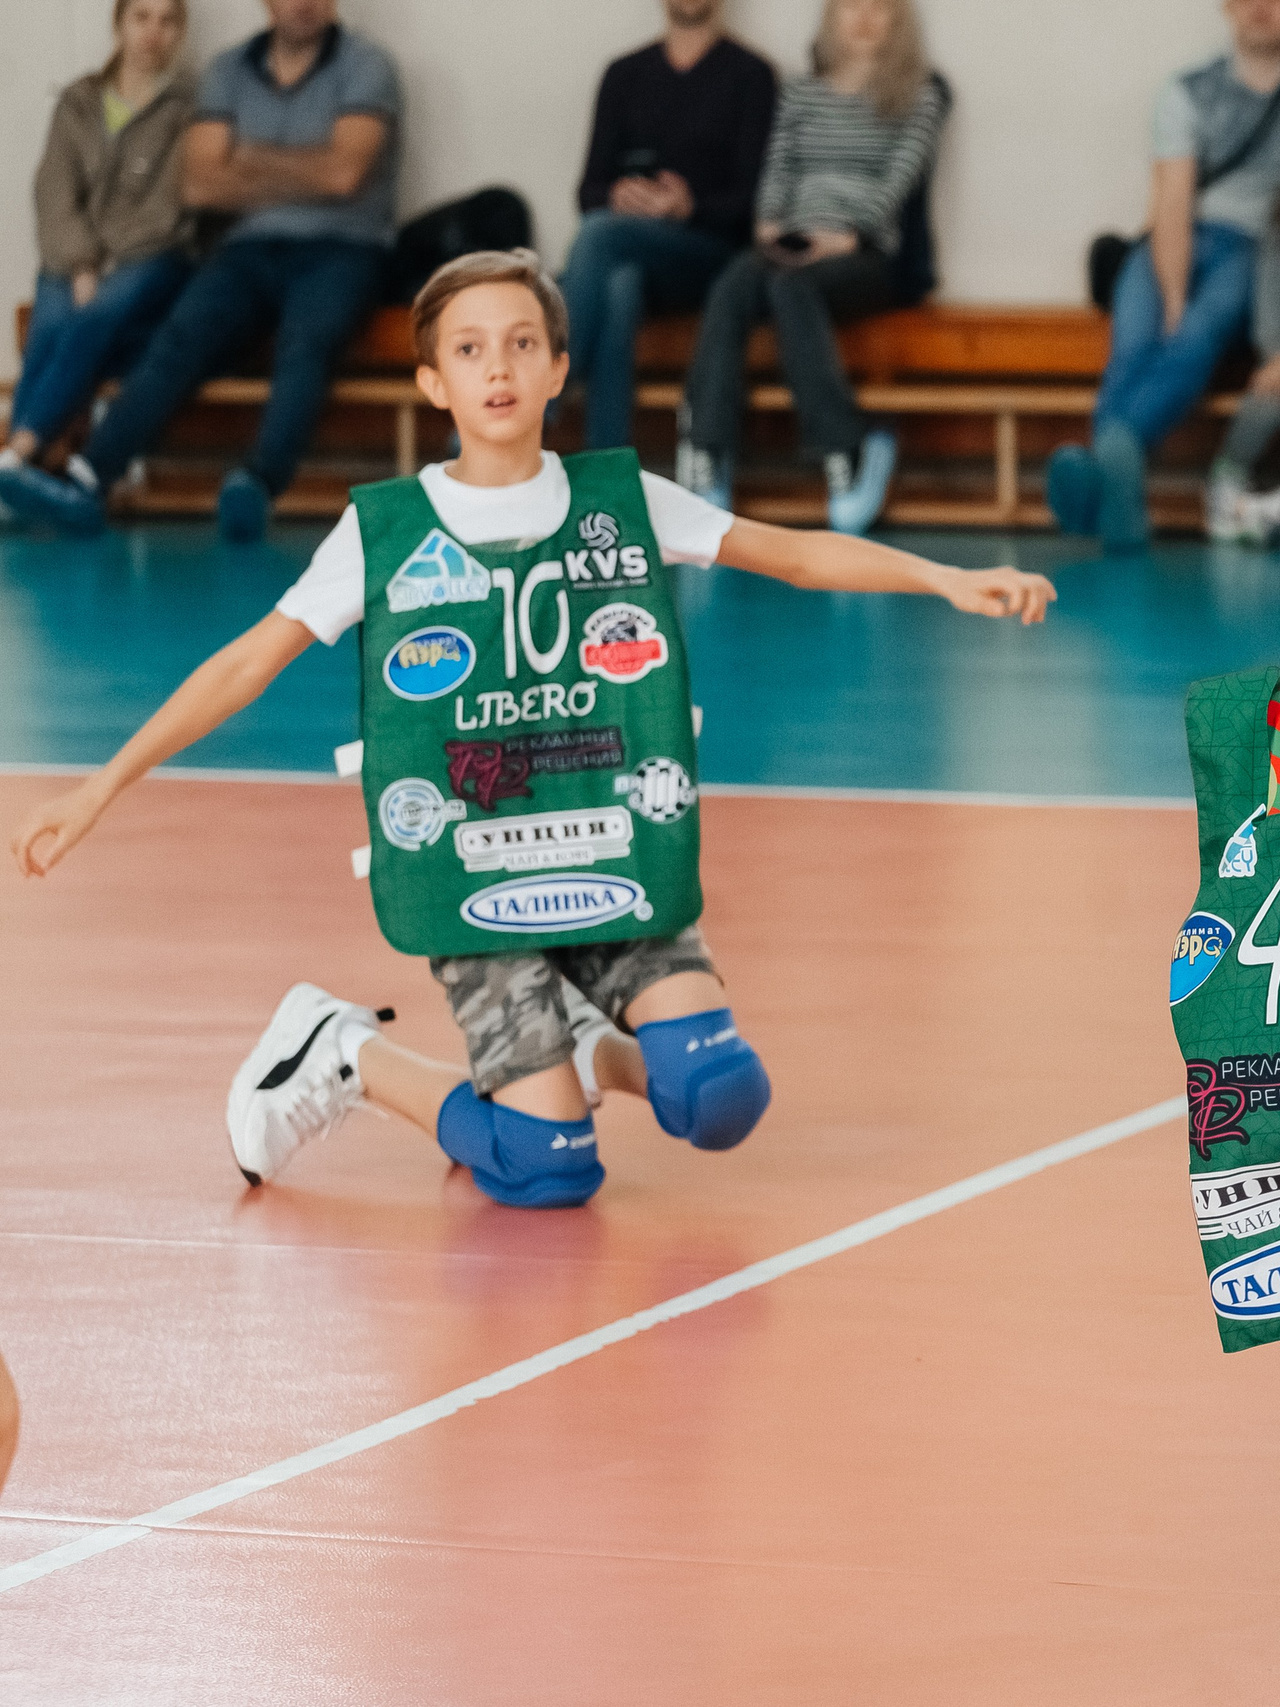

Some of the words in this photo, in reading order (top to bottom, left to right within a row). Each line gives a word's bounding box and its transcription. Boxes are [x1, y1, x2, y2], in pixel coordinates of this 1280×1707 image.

[565, 545, 648, 581] KVS
[492, 560, 570, 680] 10
[455, 680, 598, 731] LIBERO
[490, 888, 617, 918] ТАЛИНКА
[1226, 1209, 1275, 1236] ЧАЙ
